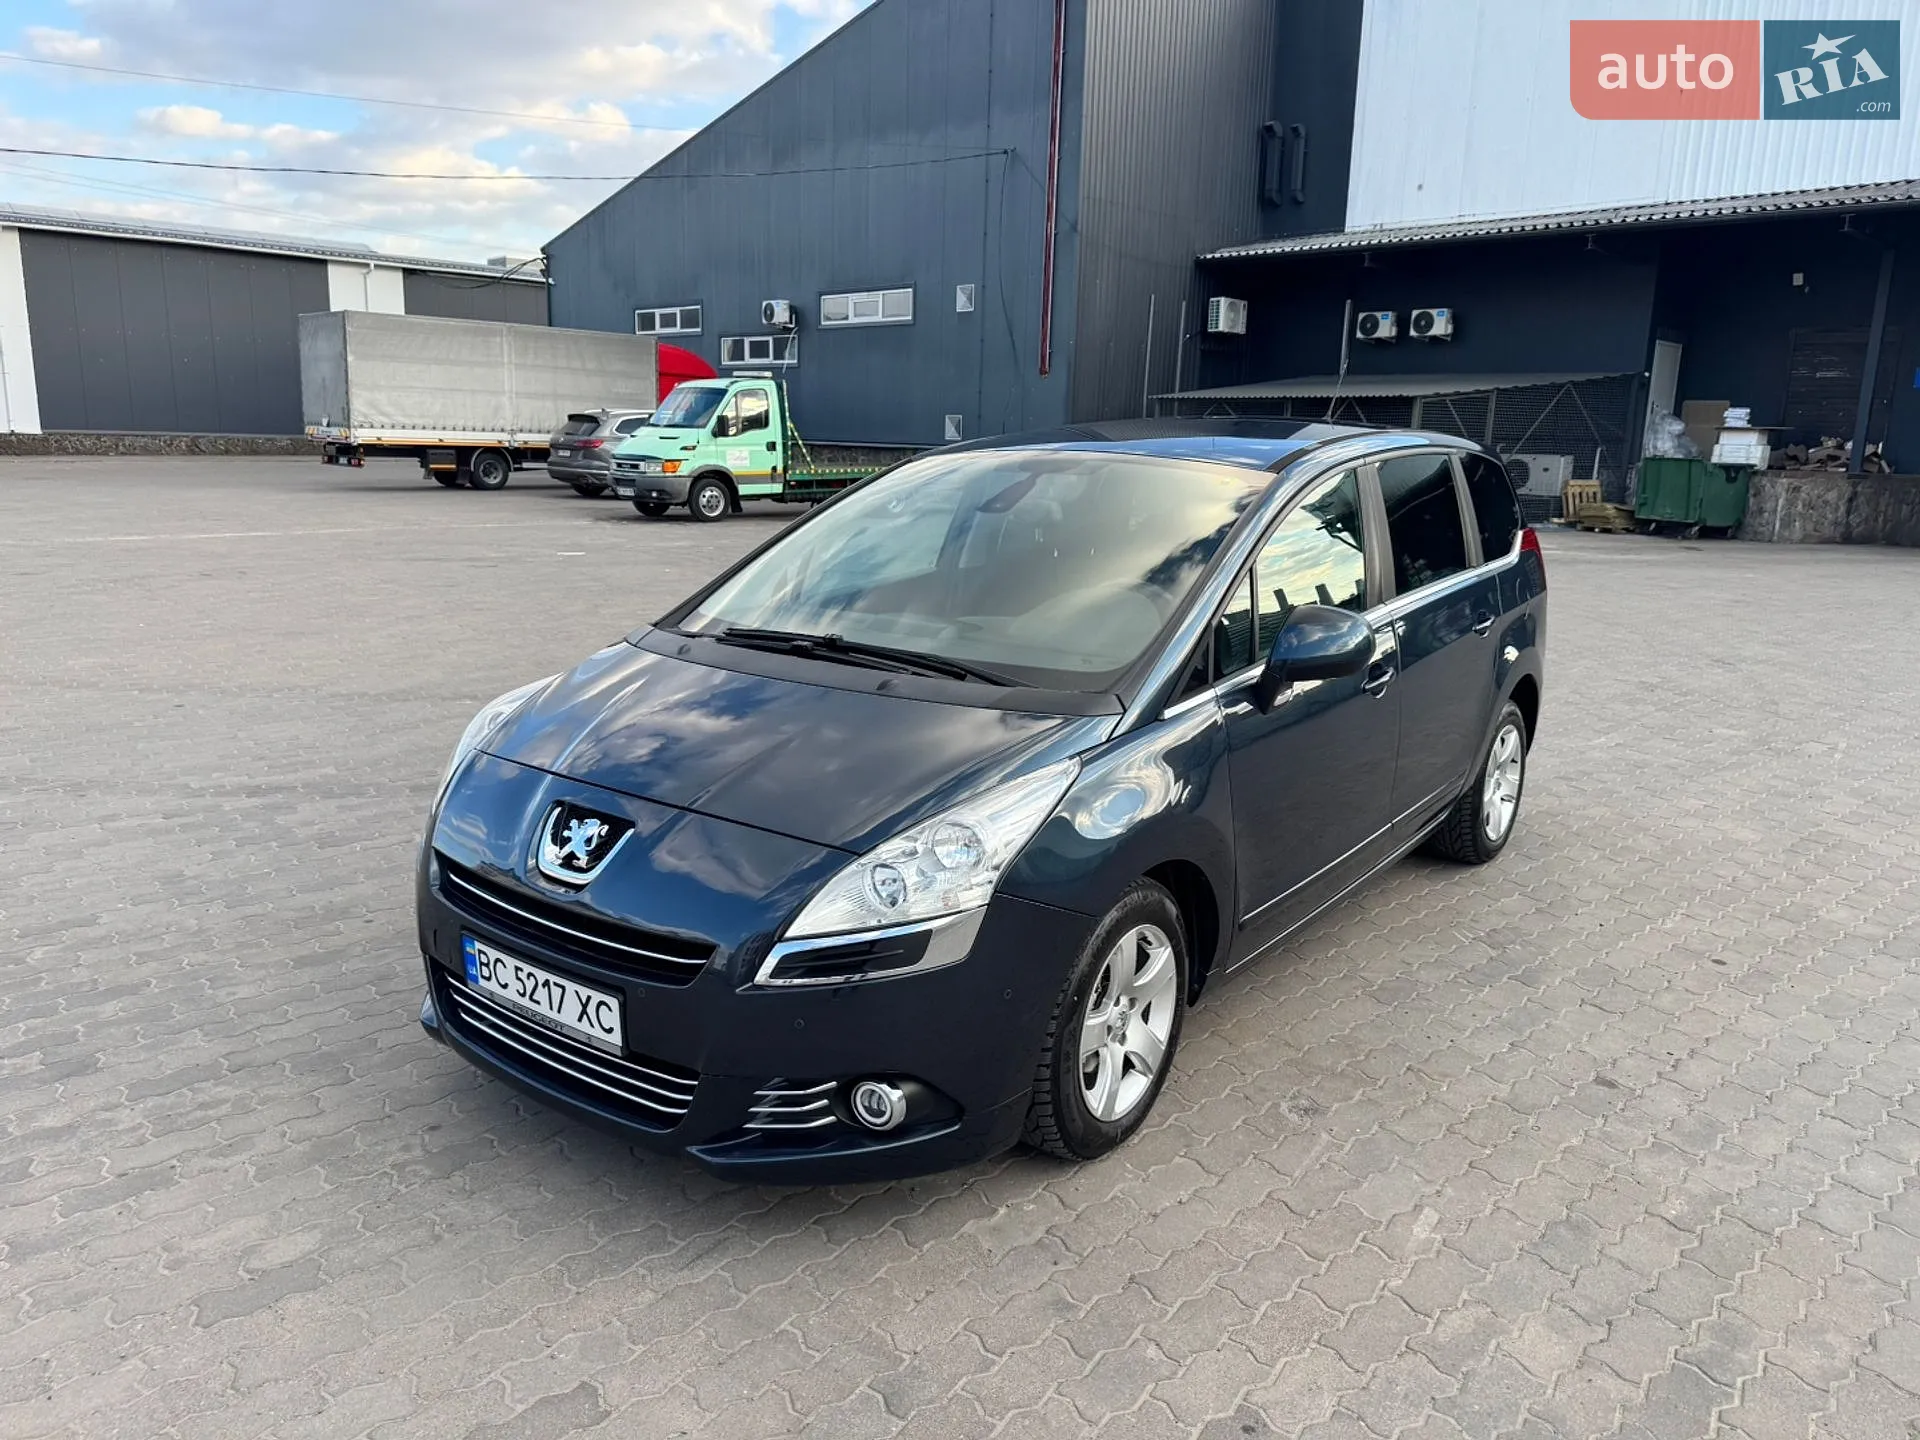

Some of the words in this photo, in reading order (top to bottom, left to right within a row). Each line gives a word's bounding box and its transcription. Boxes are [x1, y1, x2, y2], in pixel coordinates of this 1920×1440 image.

[477, 949, 509, 990] BC
[514, 965, 567, 1015] 5217
[574, 989, 615, 1035] XC
